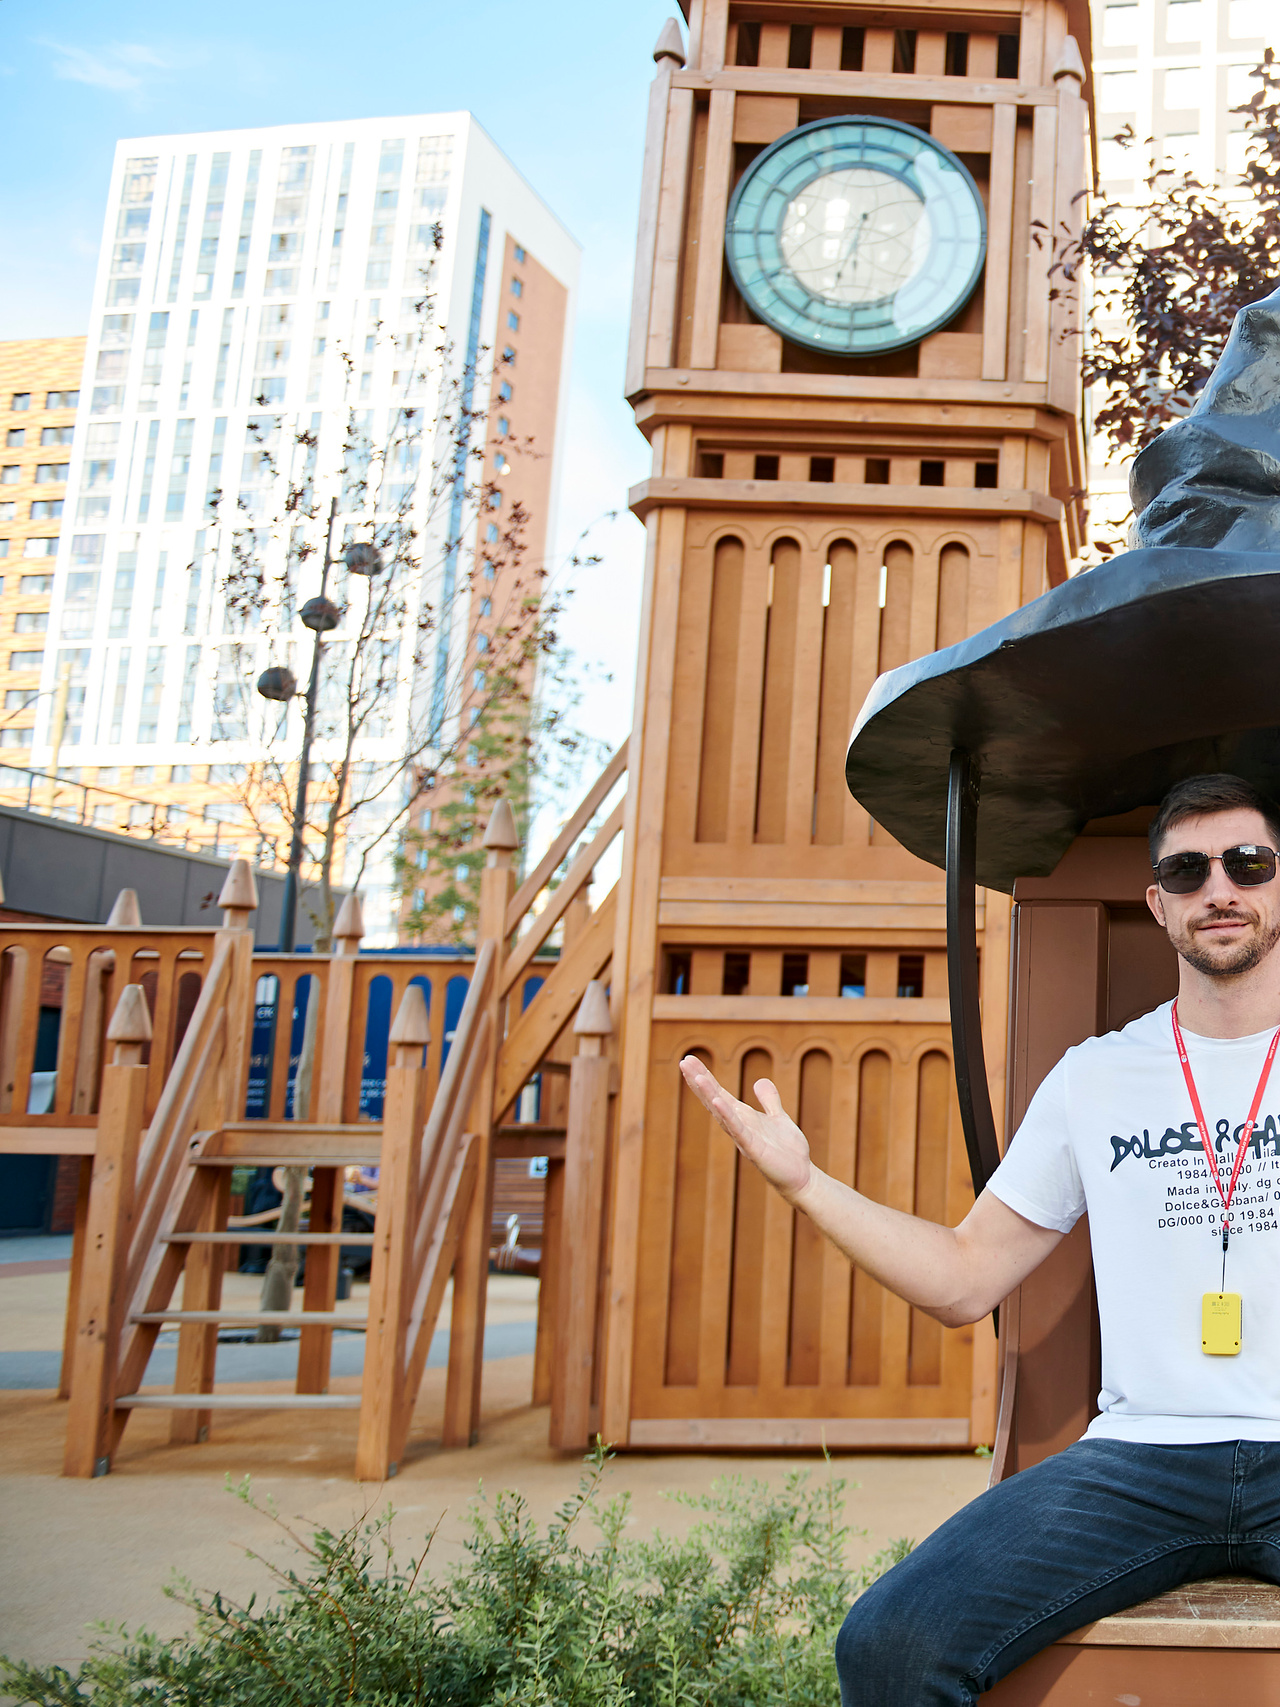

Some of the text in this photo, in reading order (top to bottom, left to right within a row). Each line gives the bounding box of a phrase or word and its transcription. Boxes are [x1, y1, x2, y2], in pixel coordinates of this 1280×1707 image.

[1149, 1158, 1189, 1169] Creato
[1258, 1162, 1267, 1172] //
[1167, 1185, 1200, 1197] Mada
[1205, 1184, 1217, 1194] in
[1256, 1178, 1271, 1189] dg
[1273, 1190, 1280, 1201] 0
[1158, 1214, 1203, 1228] DG/000
[1239, 1207, 1274, 1220] 19.84
[1211, 1220, 1278, 1237] sice 1984
